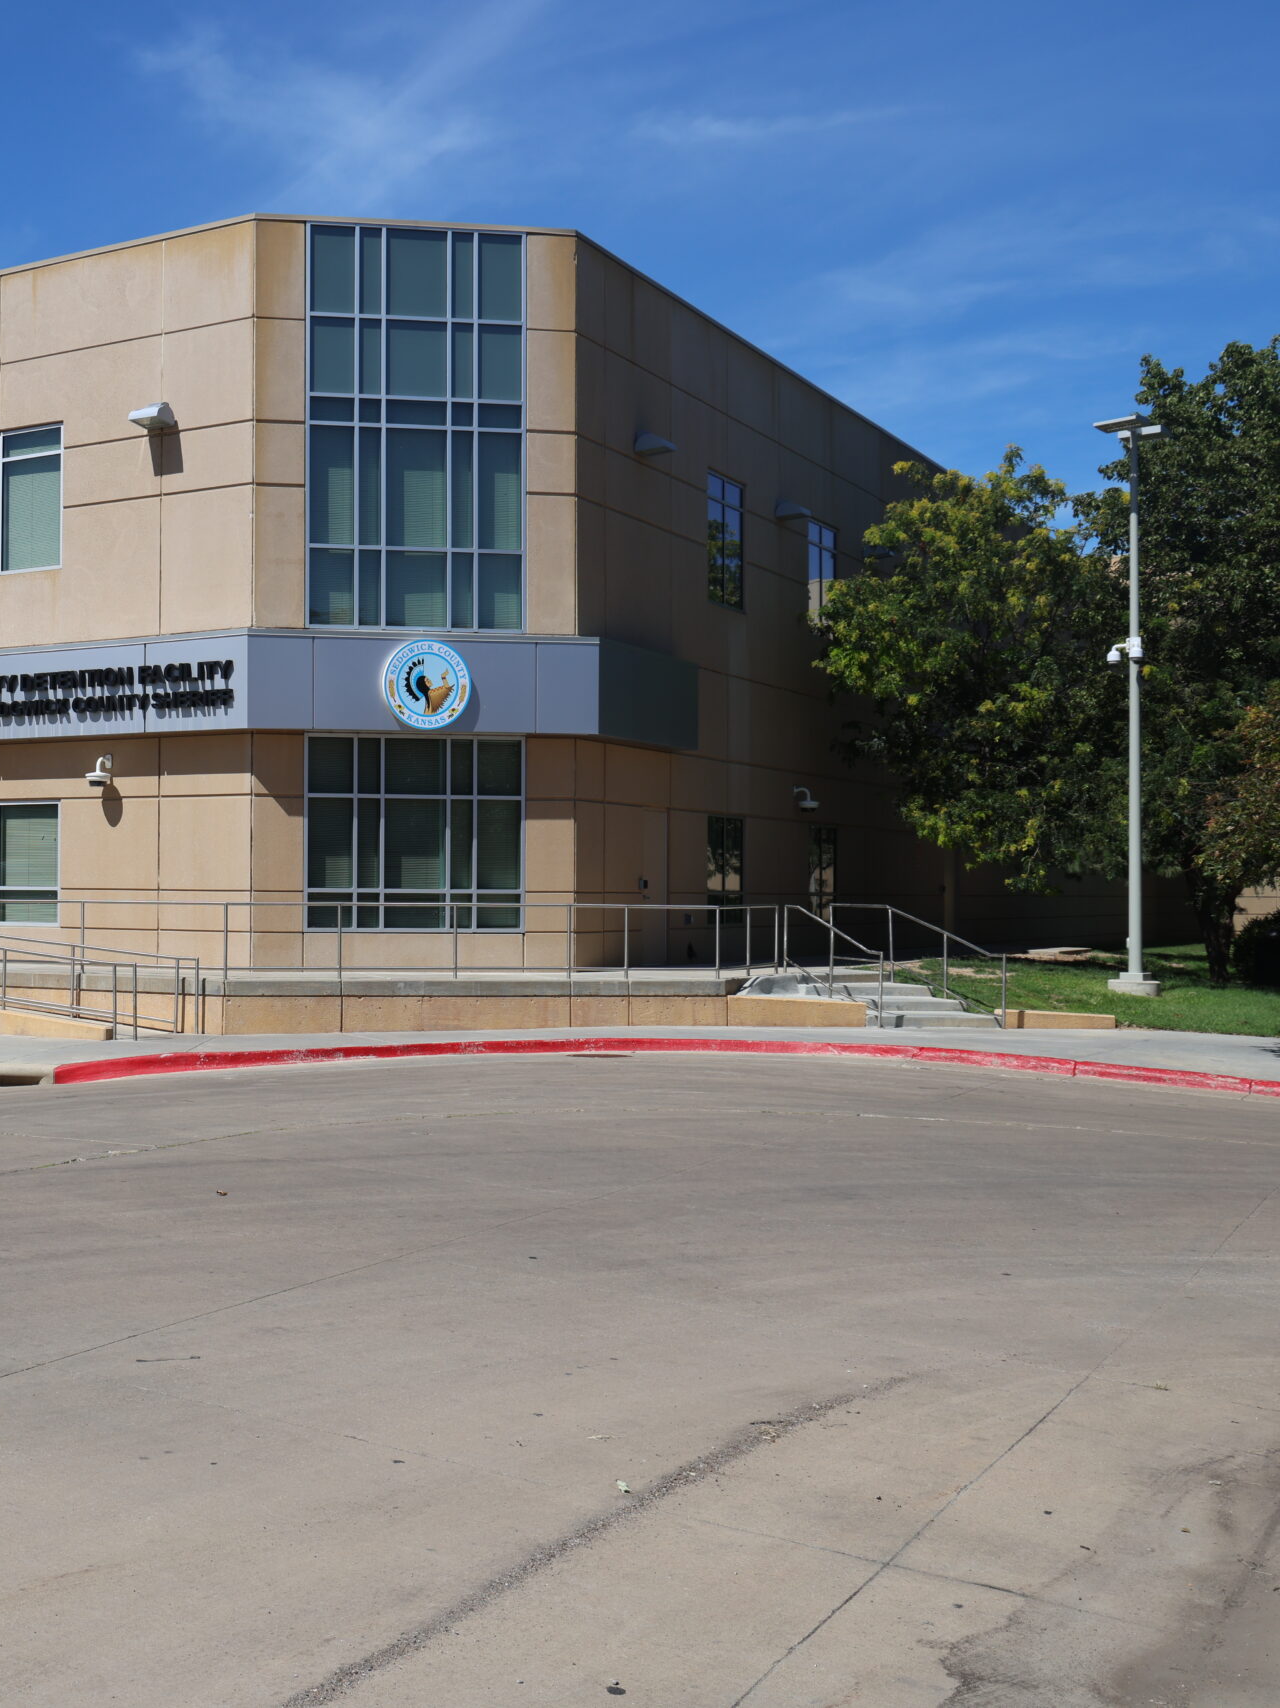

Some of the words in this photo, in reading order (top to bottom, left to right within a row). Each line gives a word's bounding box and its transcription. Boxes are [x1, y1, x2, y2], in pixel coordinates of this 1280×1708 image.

[20, 666, 134, 692] DETENTION
[138, 659, 234, 685] FACILITY
[390, 643, 434, 675] SEDGWICK
[437, 646, 467, 680] COUNTY
[72, 693, 150, 713] COUNTY
[151, 688, 234, 709] SHERIFF
[406, 716, 447, 726] KANSAS
